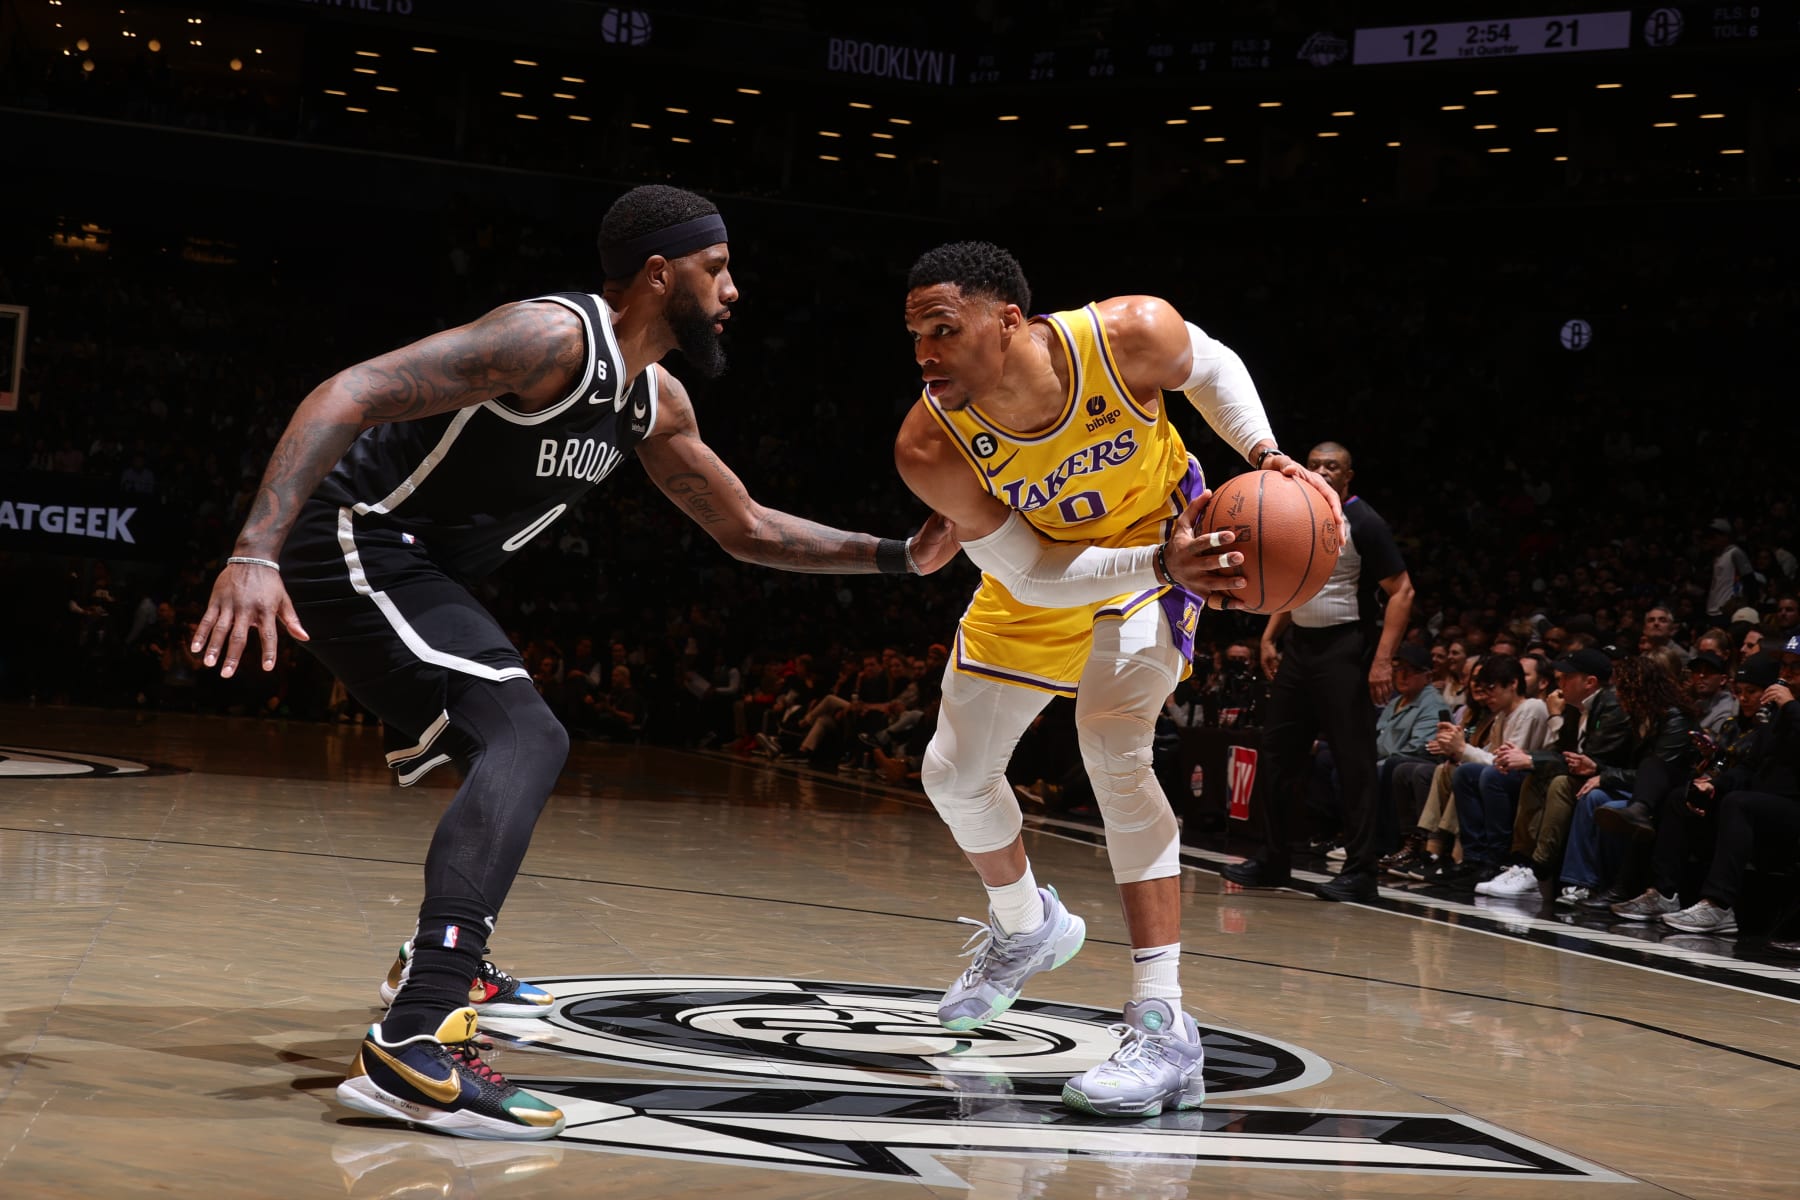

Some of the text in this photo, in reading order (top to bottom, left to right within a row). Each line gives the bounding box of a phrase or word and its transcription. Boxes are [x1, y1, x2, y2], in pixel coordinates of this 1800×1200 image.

[1403, 29, 1437, 56] 12
[1467, 23, 1510, 44] 2:54
[1545, 20, 1578, 48] 21
[827, 37, 944, 85] BROOKLYN
[1477, 44, 1518, 56] Quarter
[597, 360, 608, 380] 6
[1085, 408, 1122, 433] bibigo
[976, 436, 994, 457] 6
[536, 438, 625, 485] BROOK
[1003, 428, 1139, 512] LAKERS
[1057, 490, 1108, 524] 0
[0, 500, 137, 544] ATGEEK
[502, 503, 567, 552] 0
